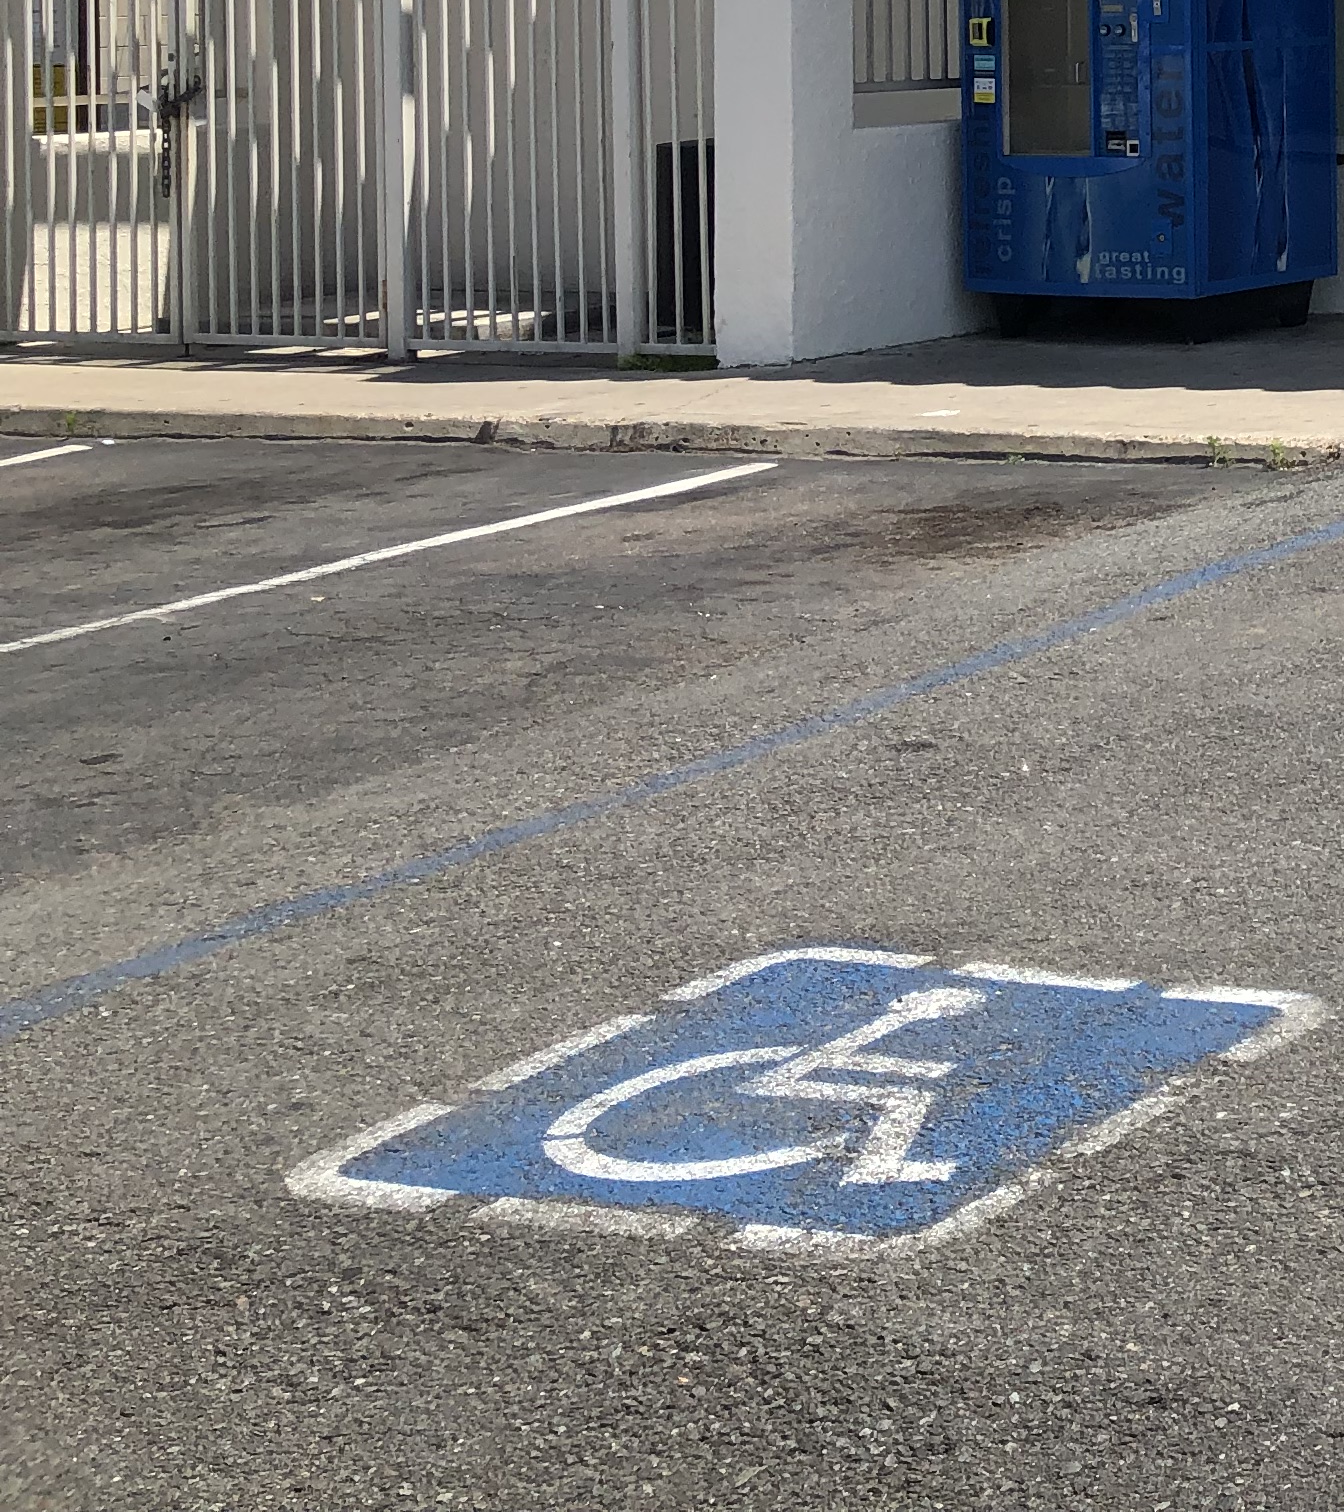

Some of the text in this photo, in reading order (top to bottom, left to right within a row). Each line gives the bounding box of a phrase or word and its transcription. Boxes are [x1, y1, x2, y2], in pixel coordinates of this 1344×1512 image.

[1151, 59, 1184, 228] water
[993, 176, 1016, 262] crisp
[1098, 249, 1150, 265] great
